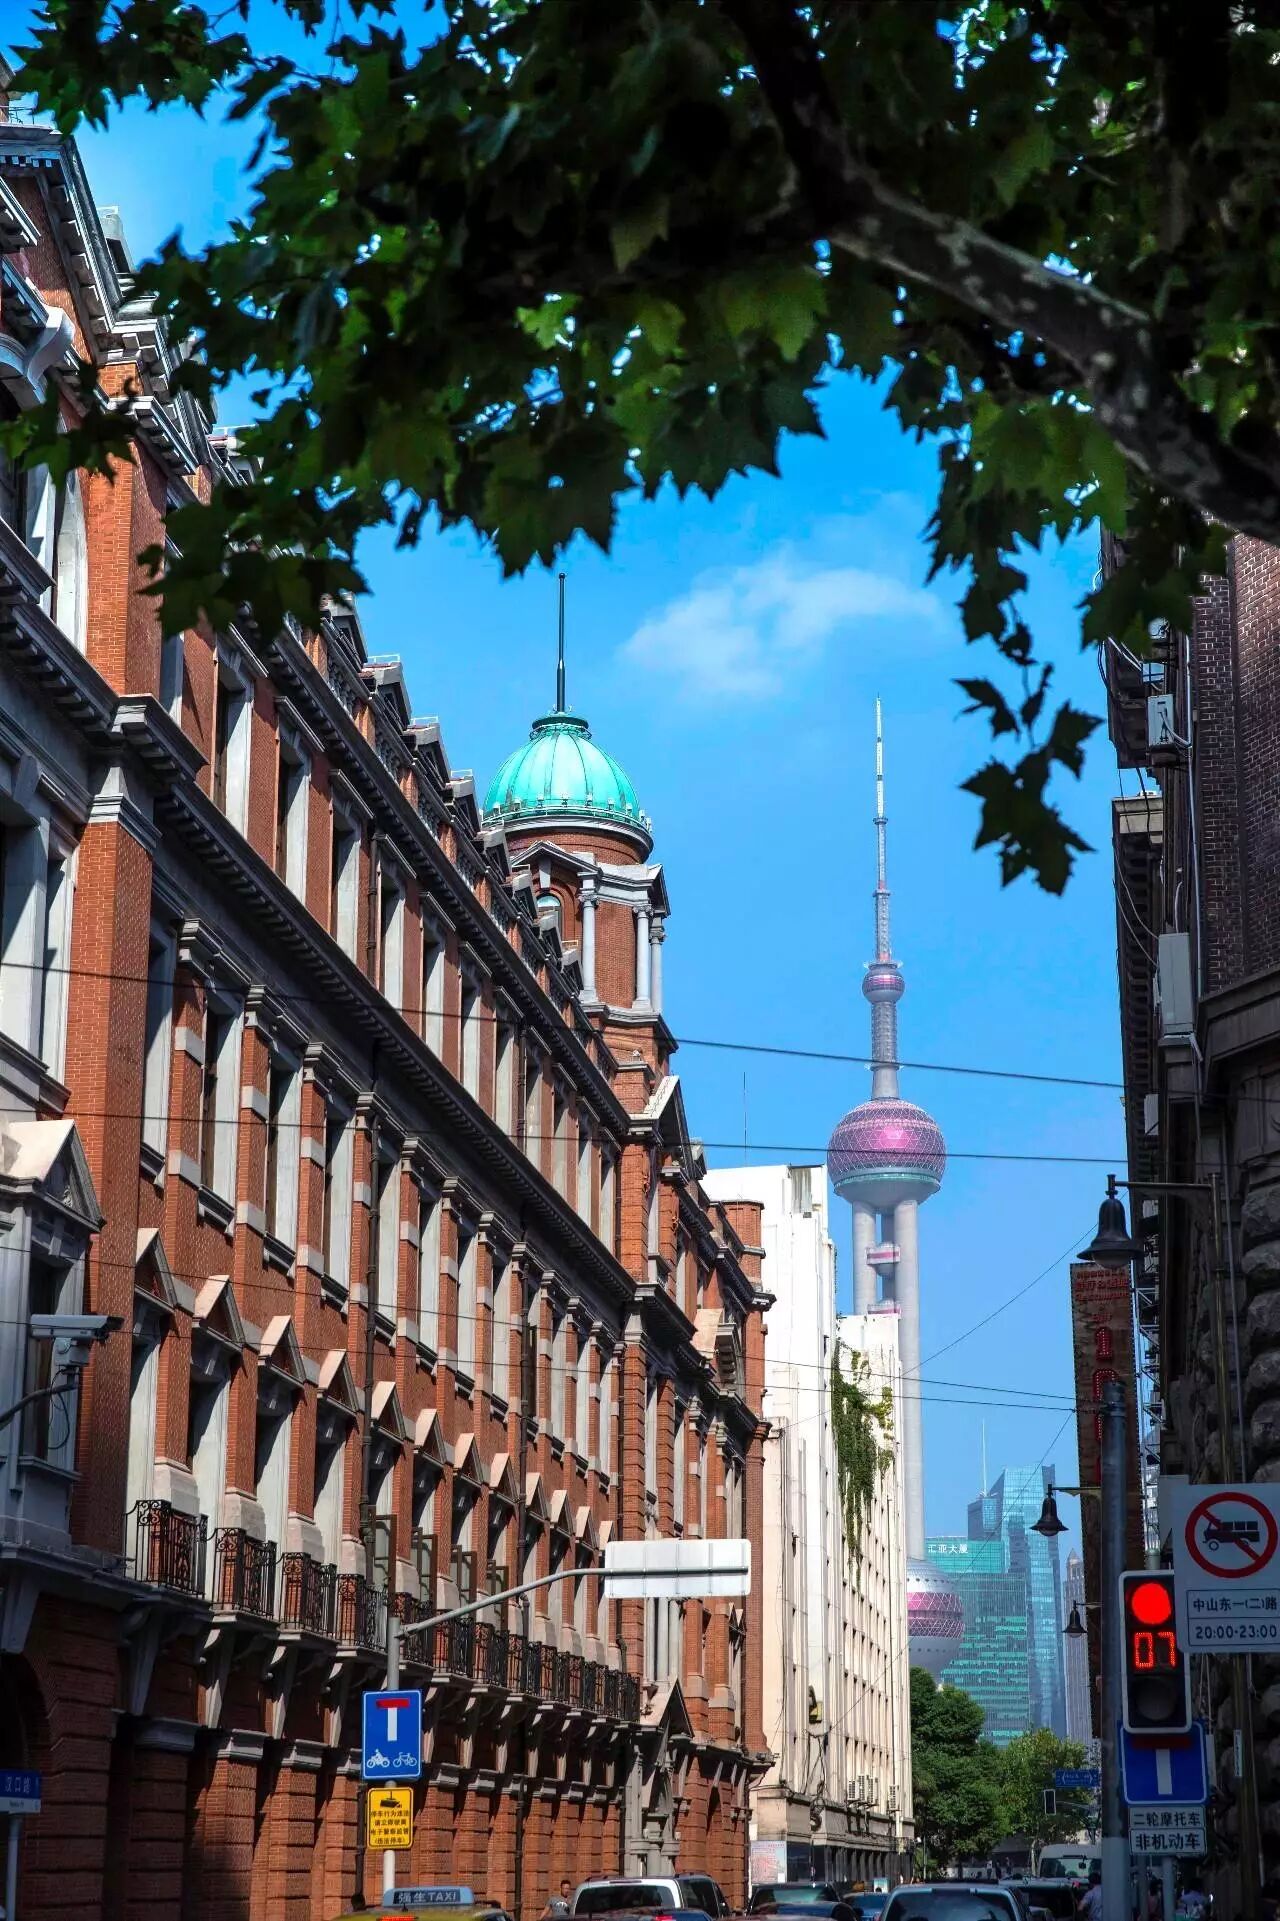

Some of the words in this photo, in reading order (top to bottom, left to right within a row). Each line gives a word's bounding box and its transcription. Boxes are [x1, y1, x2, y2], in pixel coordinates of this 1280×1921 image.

[927, 1544, 968, 1554] 汇亚大厦
[1134, 1632, 1176, 1668] 07
[1134, 1812, 1200, 1826] 二轮摩托车
[1135, 1833, 1200, 1850] 非机动车
[427, 1891, 457, 1902] TAXI
